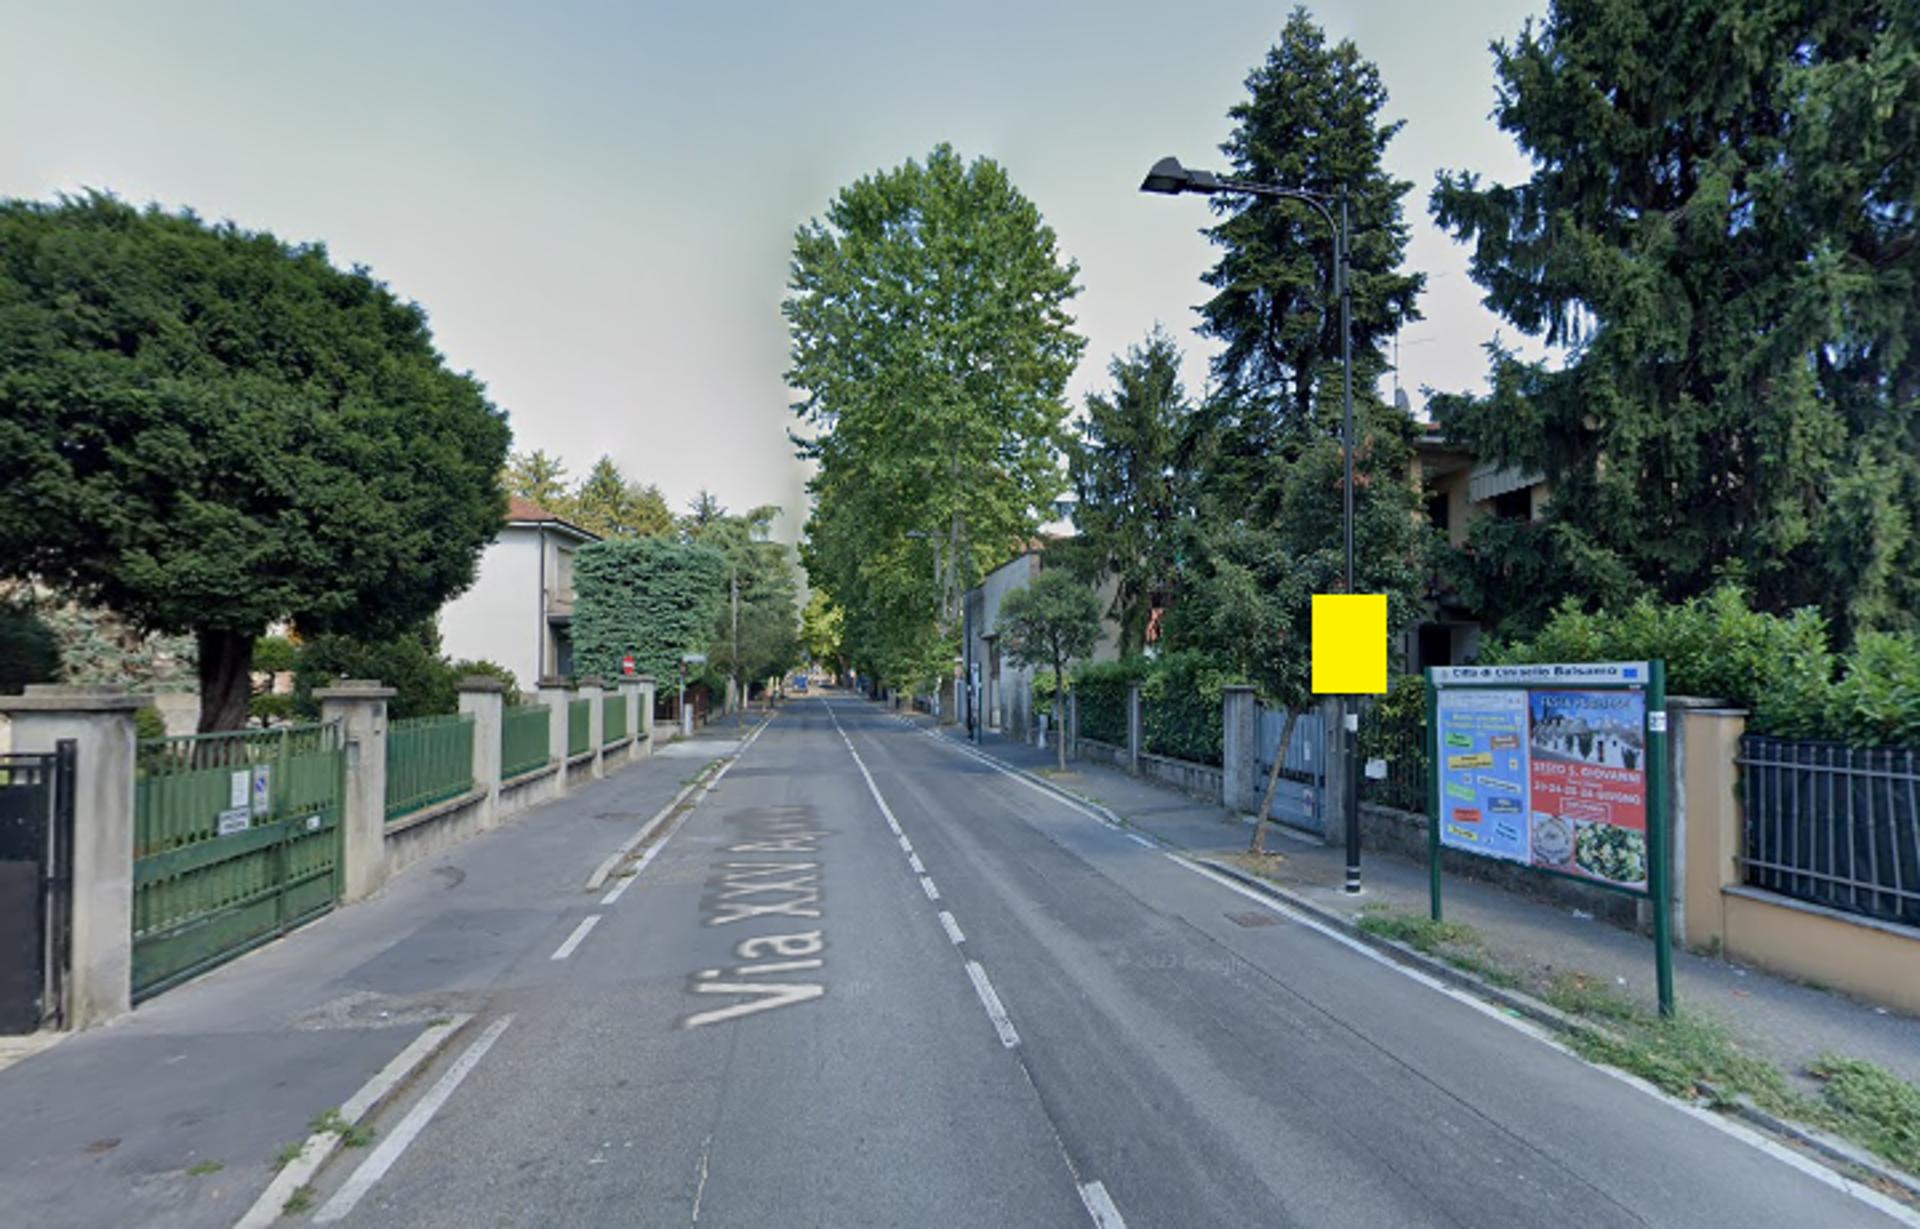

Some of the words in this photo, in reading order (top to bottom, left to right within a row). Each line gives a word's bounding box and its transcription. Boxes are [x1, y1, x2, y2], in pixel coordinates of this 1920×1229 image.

[1480, 666, 1491, 677] di
[1554, 666, 1617, 676] Balsamo
[1581, 767, 1641, 784] GIOVANNI
